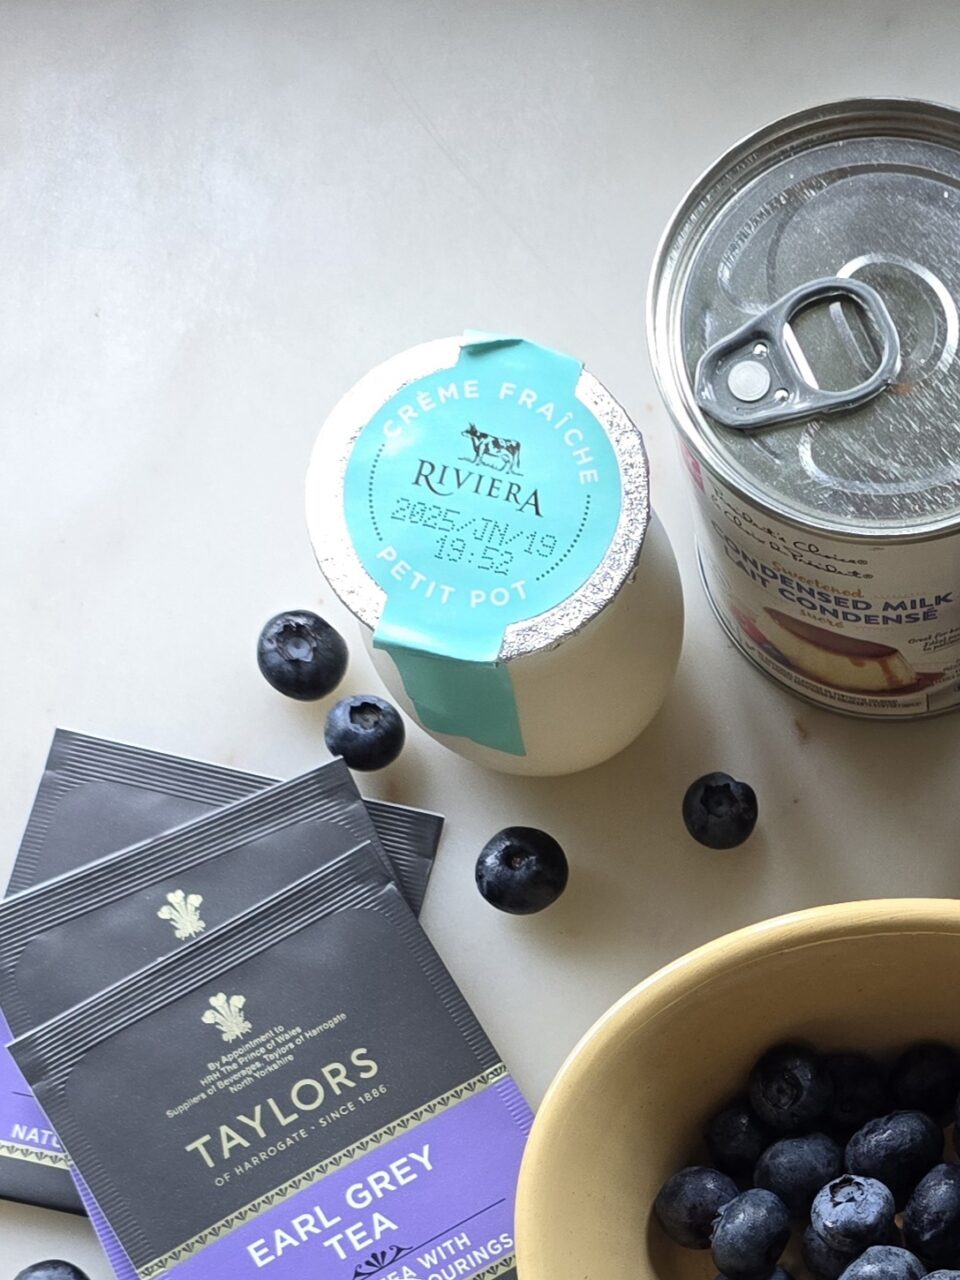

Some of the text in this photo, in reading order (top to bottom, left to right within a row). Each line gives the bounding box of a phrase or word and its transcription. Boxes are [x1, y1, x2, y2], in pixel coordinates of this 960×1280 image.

[383, 380, 599, 486] CRÈME FRAÎCHE
[411, 458, 544, 519] RIVIERA
[376, 546, 529, 608] PETIT POT
[711, 519, 953, 611] CONDENSED MILK
[724, 544, 938, 625] LAIT CONDENSÉ
[772, 560, 864, 598] Sweetened
[165, 1091, 208, 1119] Suppliers
[208, 1084, 217, 1096] of
[263, 1042, 295, 1062] Taylors
[296, 1034, 305, 1046] of
[305, 1012, 347, 1039] Harrogate
[200, 1026, 302, 1087] HRH The Prince of Wales
[207, 1025, 285, 1073] By Appointment to
[229, 1053, 295, 1094] North Yorkshire
[185, 1047, 379, 1168] TAYLORS
[214, 1083, 388, 1187] OF HARROGATE SINCE 1886
[246, 1144, 434, 1268] EARL GREY
[323, 1212, 399, 1260] TEA
[416, 1232, 472, 1270] WITH
